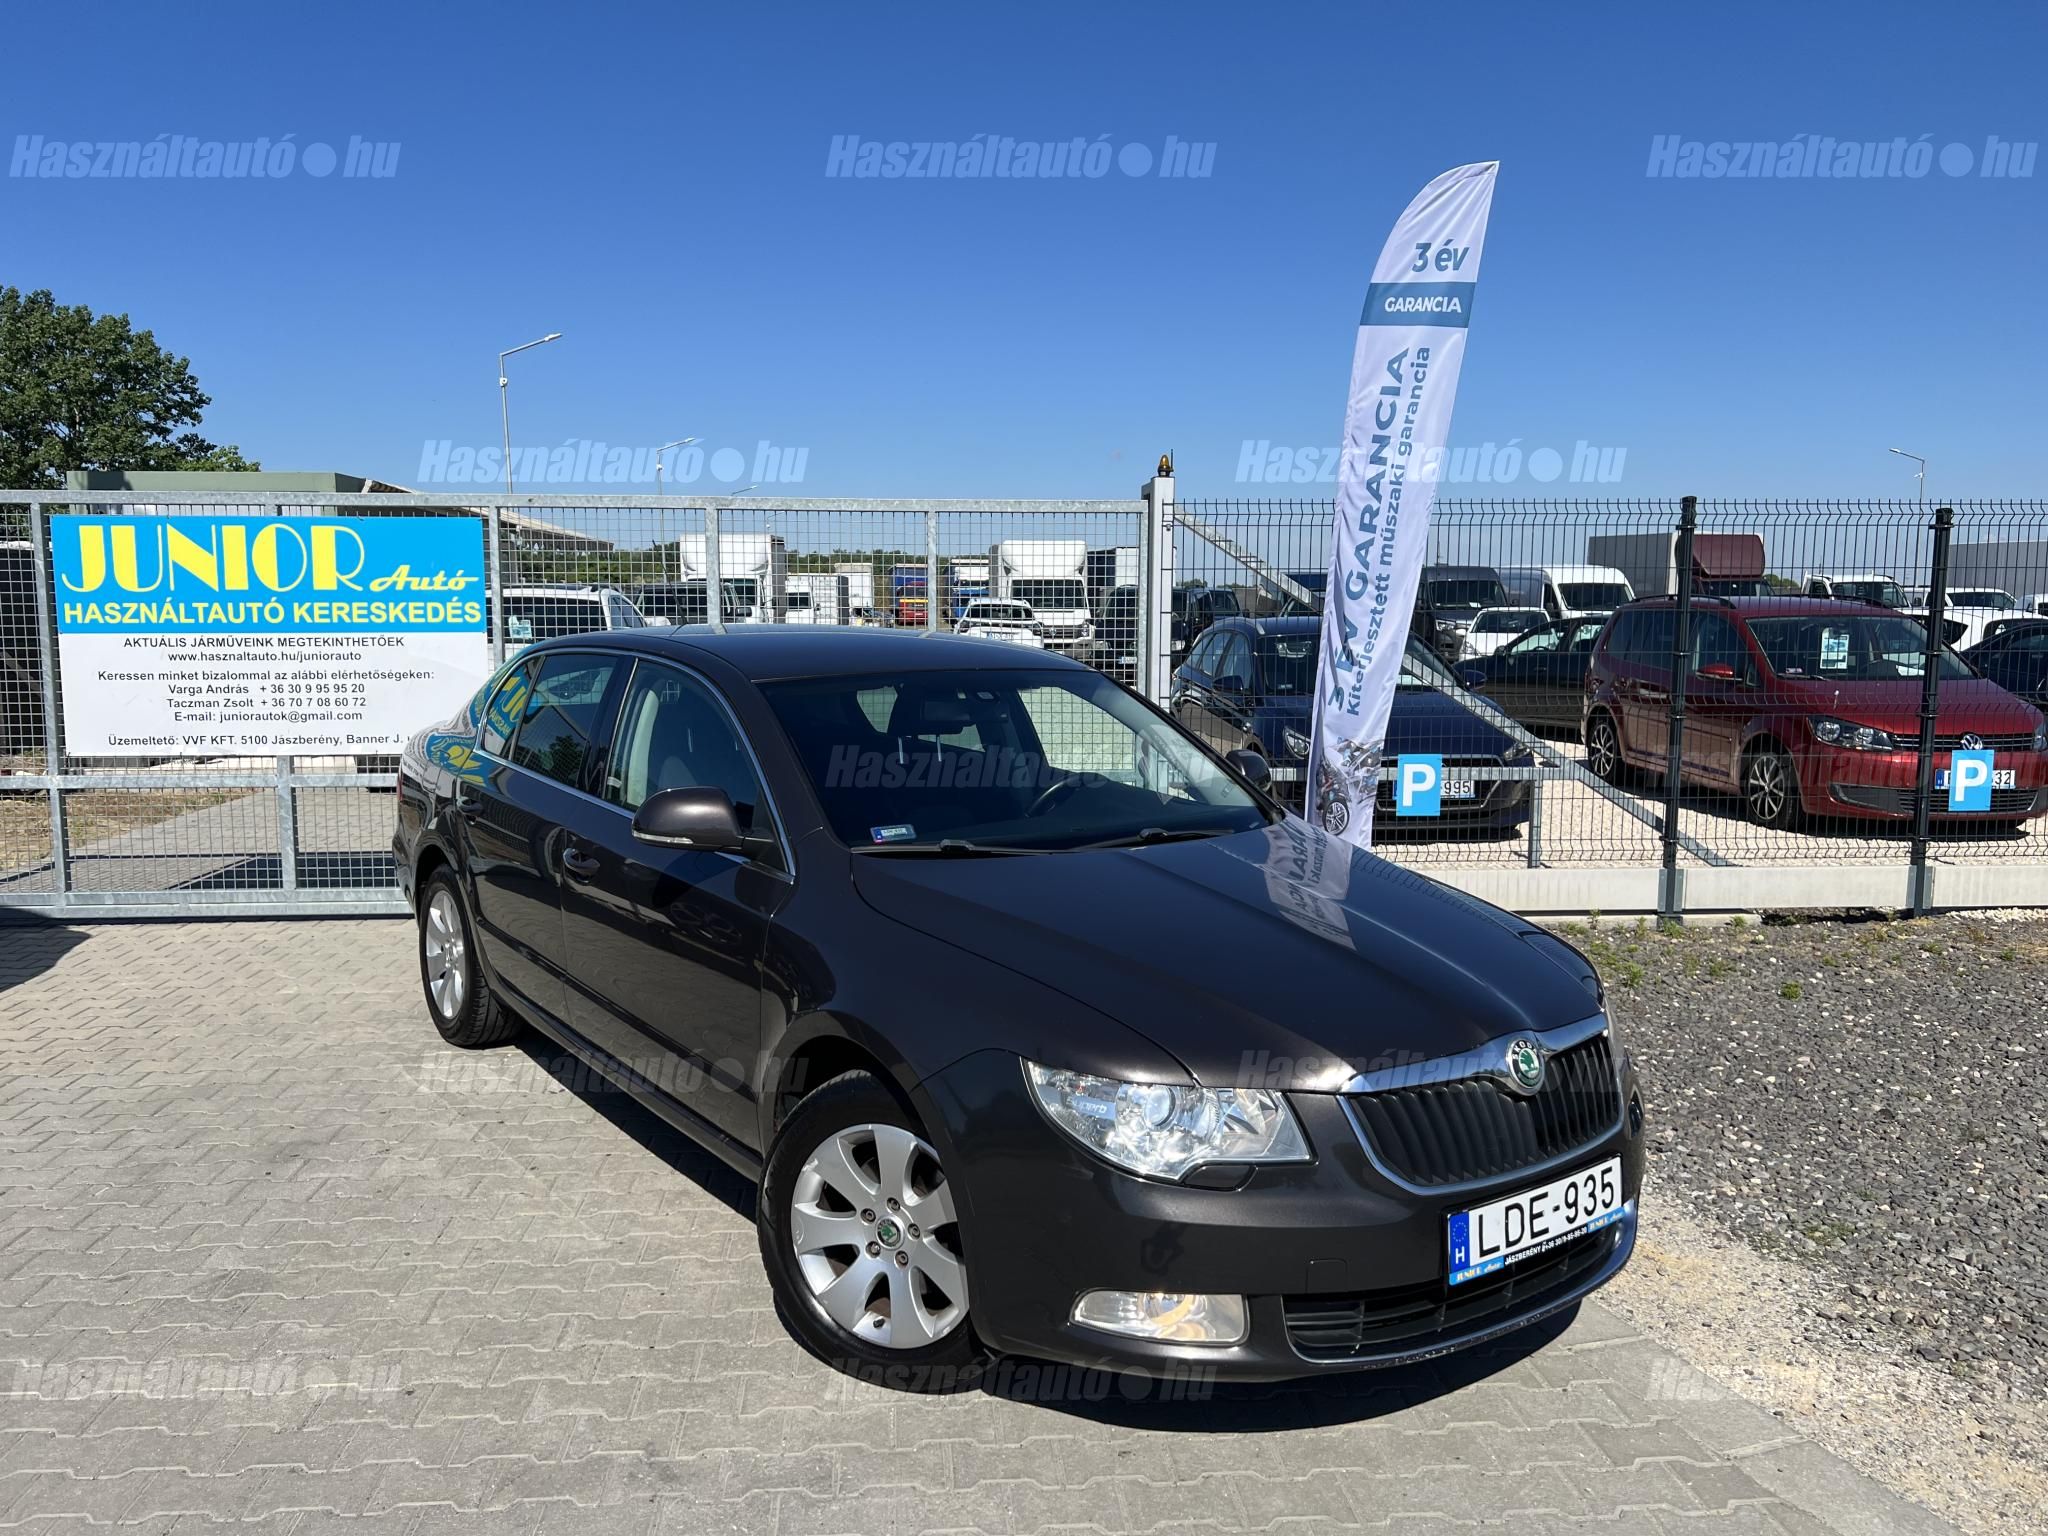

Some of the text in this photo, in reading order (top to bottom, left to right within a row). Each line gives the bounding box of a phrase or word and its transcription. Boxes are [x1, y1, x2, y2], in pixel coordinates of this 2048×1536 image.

[1412, 239, 1469, 272] 3 év
[1385, 297, 1462, 313] GARANCIA
[1328, 685, 1345, 712] 3
[1346, 347, 1410, 601] GARANCIA
[1347, 573, 1391, 716] Kiterjesztett
[1398, 347, 1430, 456] garancia
[61, 523, 479, 592] JUNIOR Autó
[64, 596, 481, 624] HASZNÁLTAUTÓ KERESKEDÉS
[124, 634, 405, 648] AKTUÁLIS JÁRMŰVEINK MEGTEKINTHETŐEK
[168, 651, 362, 663] www.hasznaltauto.hu/juniorauto
[98, 671, 154, 681] Keressen
[158, 671, 199, 681] minket
[202, 670, 270, 681] bizalommal
[291, 670, 327, 680] alábbi
[331, 669, 435, 681] elérhetőségeken:
[168, 684, 203, 696] Varga
[206, 684, 249, 694] András
[271, 684, 284, 693] 36
[288, 684, 301, 693] 30
[305, 684, 312, 693] 9
[315, 683, 330, 693] 95
[333, 683, 348, 693] 95
[351, 683, 365, 693] 20
[166, 698, 219, 708] Taczman
[223, 698, 254, 708] Zsolt
[271, 697, 285, 707] 36
[289, 697, 302, 707] 70
[306, 697, 313, 707] 7
[317, 697, 330, 707] 08
[334, 697, 348, 707] 60
[352, 697, 366, 707] 72
[174, 711, 363, 723] E-mail: juniorautok@gmail.com
[108, 733, 403, 746] Üzemeltető: VVF KFT. 5100 Jászberény, Banner J.
[1403, 763, 1436, 806] P
[1955, 759, 1988, 802] P
[1478, 1166, 1614, 1258] LDE-935
[1455, 1246, 1466, 1264] H
